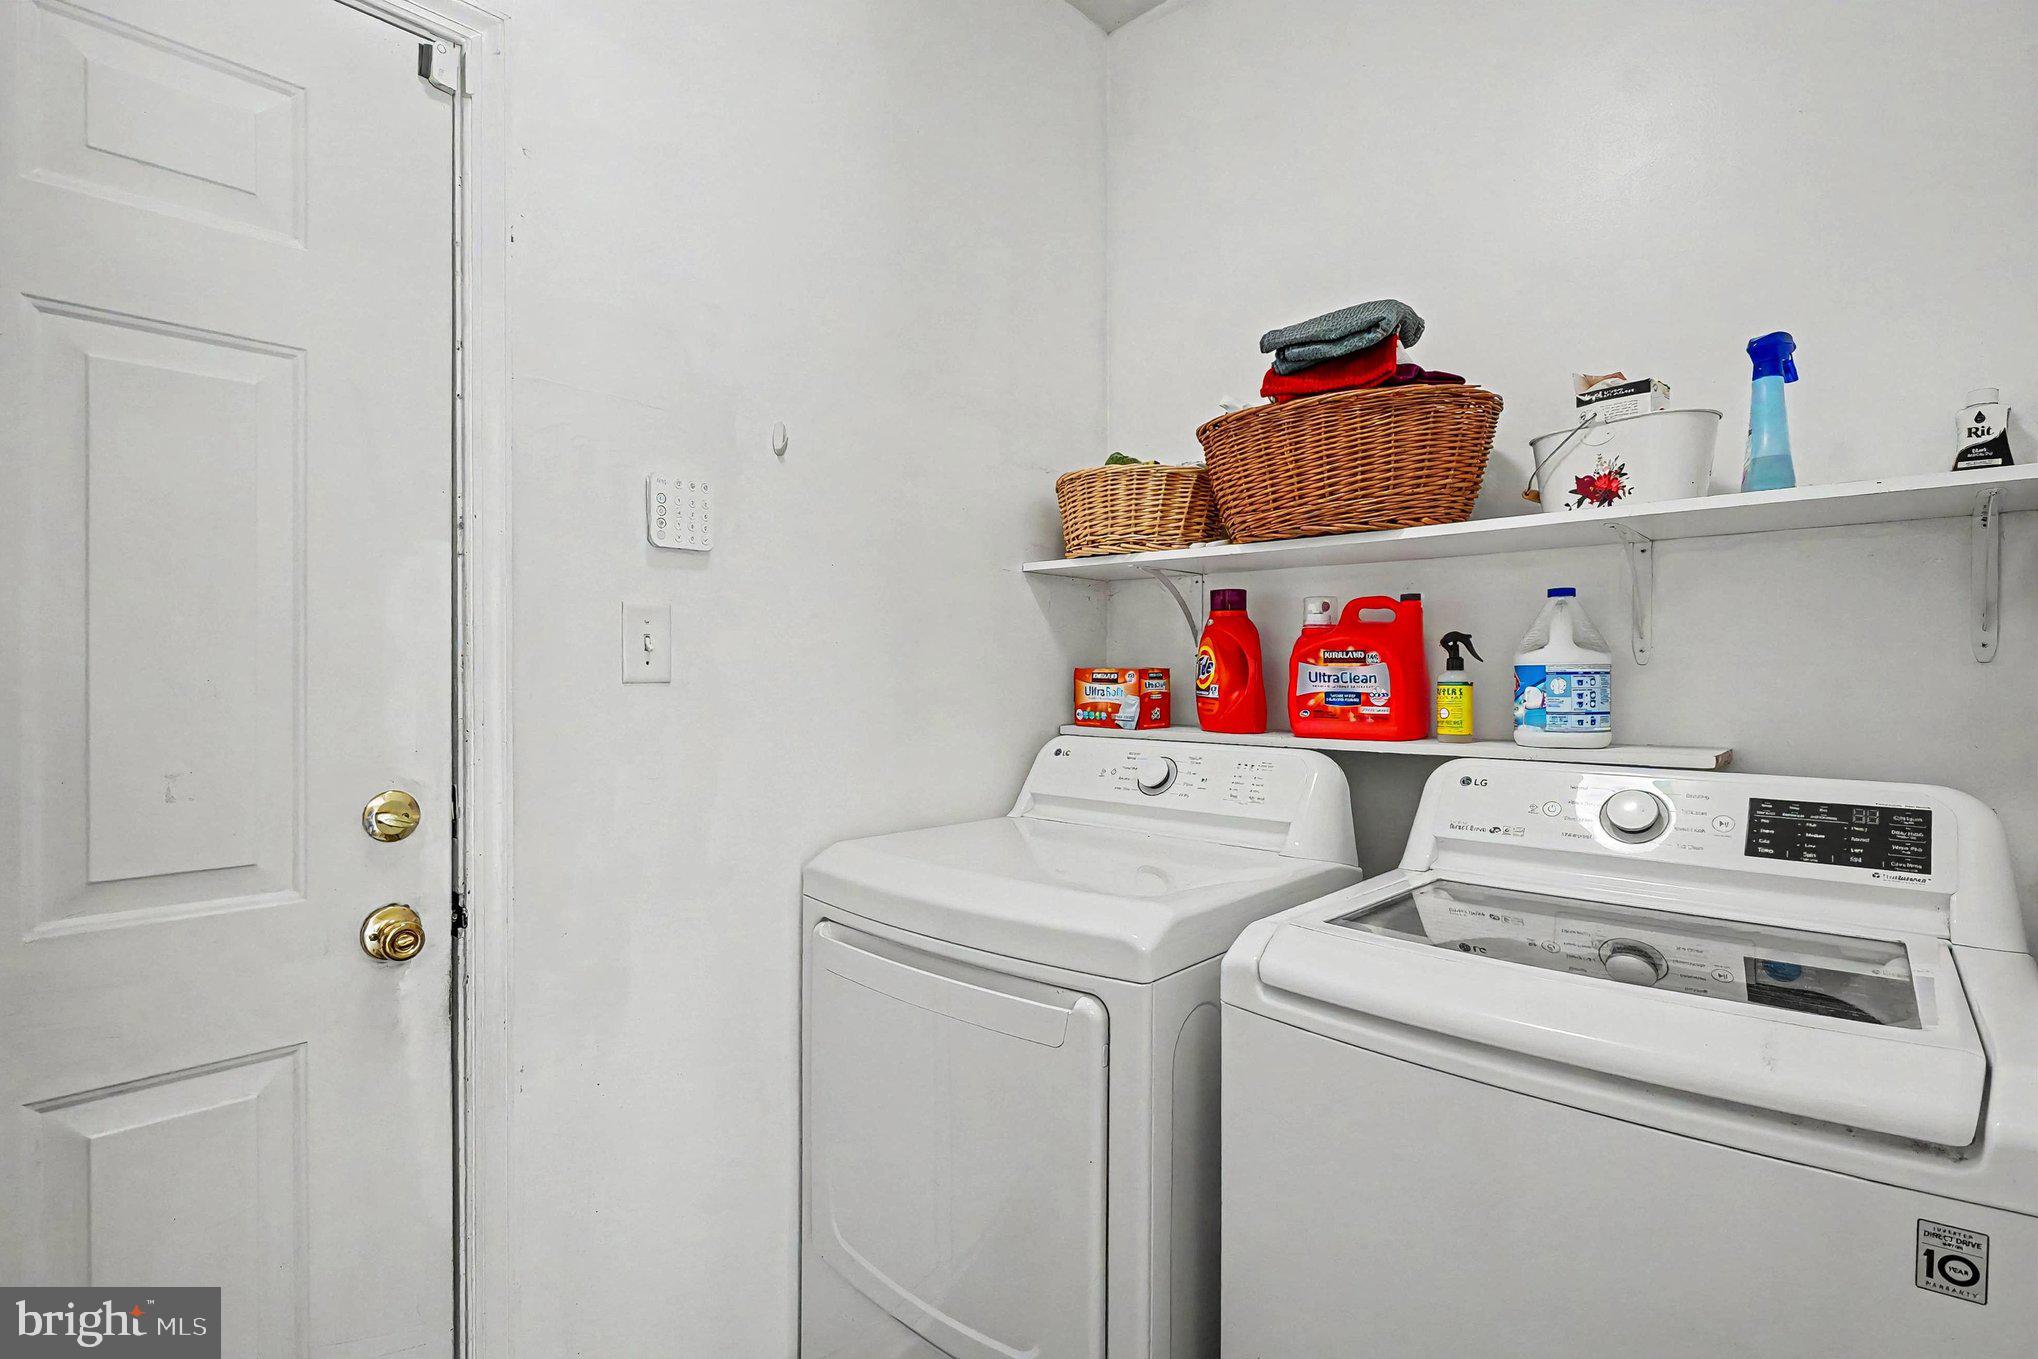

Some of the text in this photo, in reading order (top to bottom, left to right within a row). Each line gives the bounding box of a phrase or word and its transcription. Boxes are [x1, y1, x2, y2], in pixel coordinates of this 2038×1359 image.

[1967, 425, 1994, 438] Rit
[1324, 651, 1365, 659] KIRKLAND
[1308, 671, 1377, 684] UltraClean
[1474, 778, 1488, 787] LG
[1923, 1230, 1954, 1243] DIRECT
[1956, 1238, 1983, 1250] DRIVE
[1923, 1248, 1980, 1287] 10
[1948, 1266, 1969, 1277] YEAR
[1925, 1280, 1979, 1299] WARRANTY
